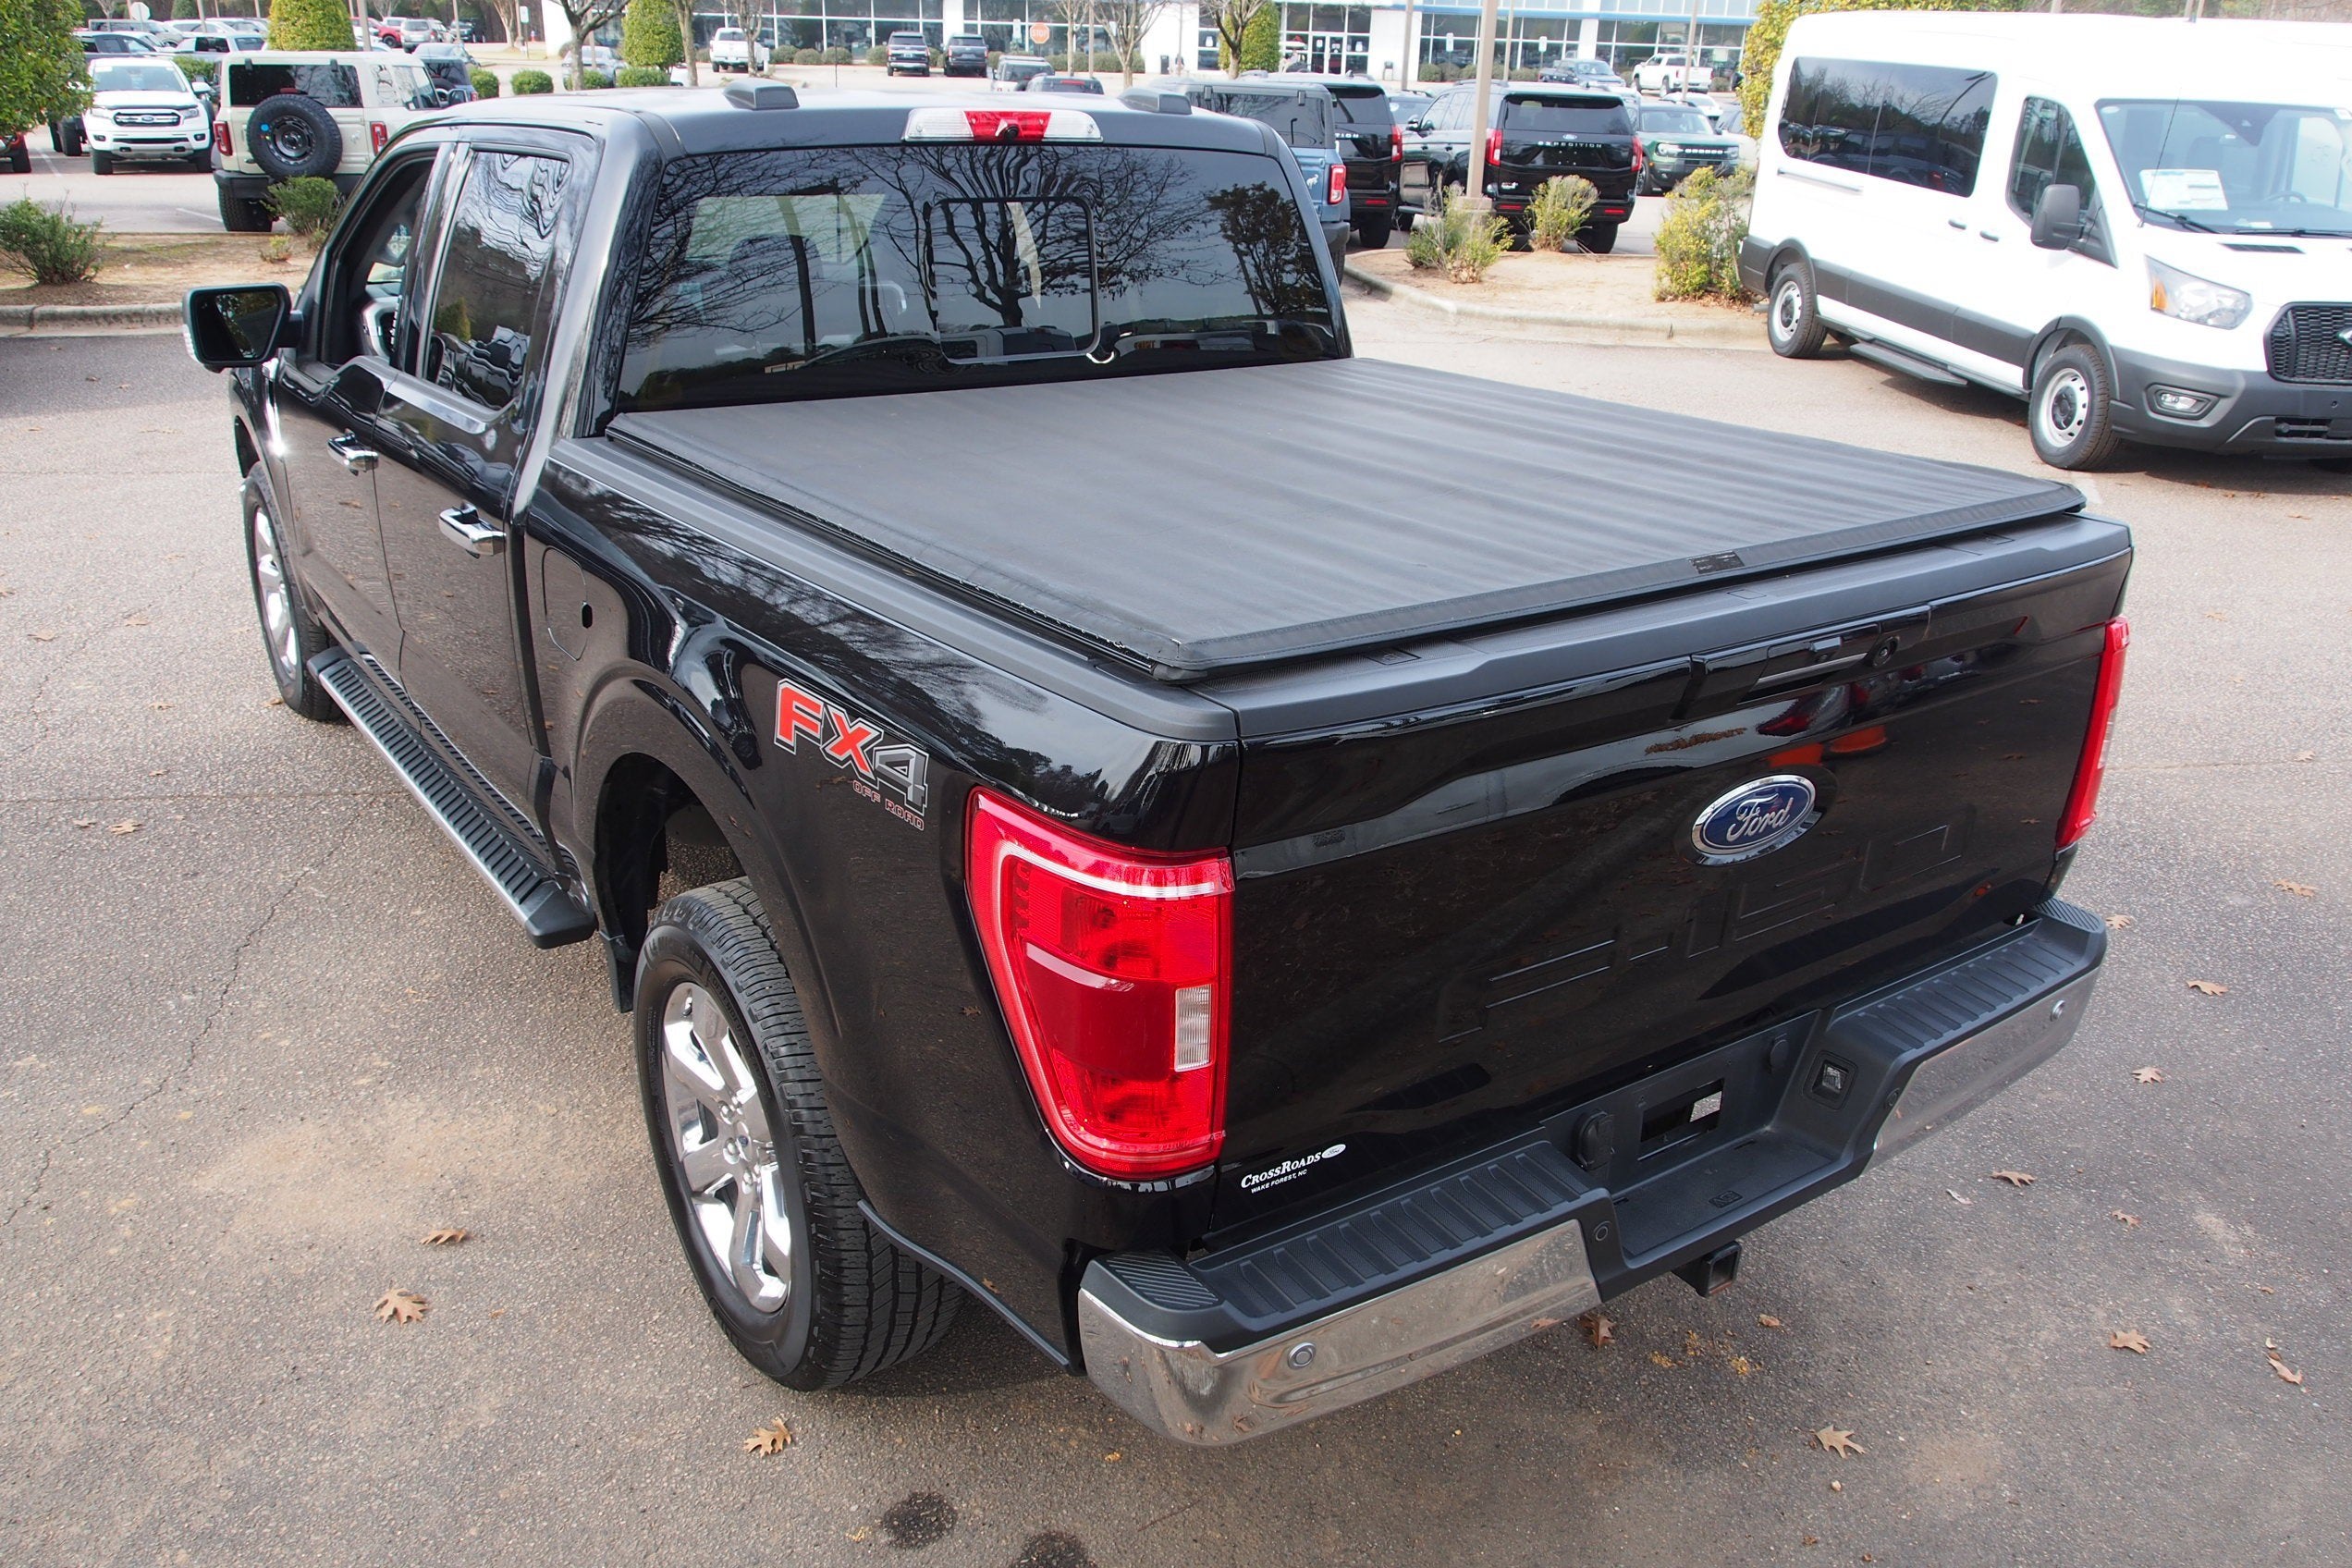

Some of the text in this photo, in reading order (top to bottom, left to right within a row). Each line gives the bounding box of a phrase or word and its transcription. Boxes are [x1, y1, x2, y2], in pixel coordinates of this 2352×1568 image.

[1537, 141, 1602, 149] EXPEDITION
[774, 678, 929, 816] FX4
[852, 779, 925, 831] OFF ROAD
[1726, 792, 1795, 842] Ford
[1251, 1181, 1270, 1194] WAKE
[1297, 1169, 1308, 1177] NC
